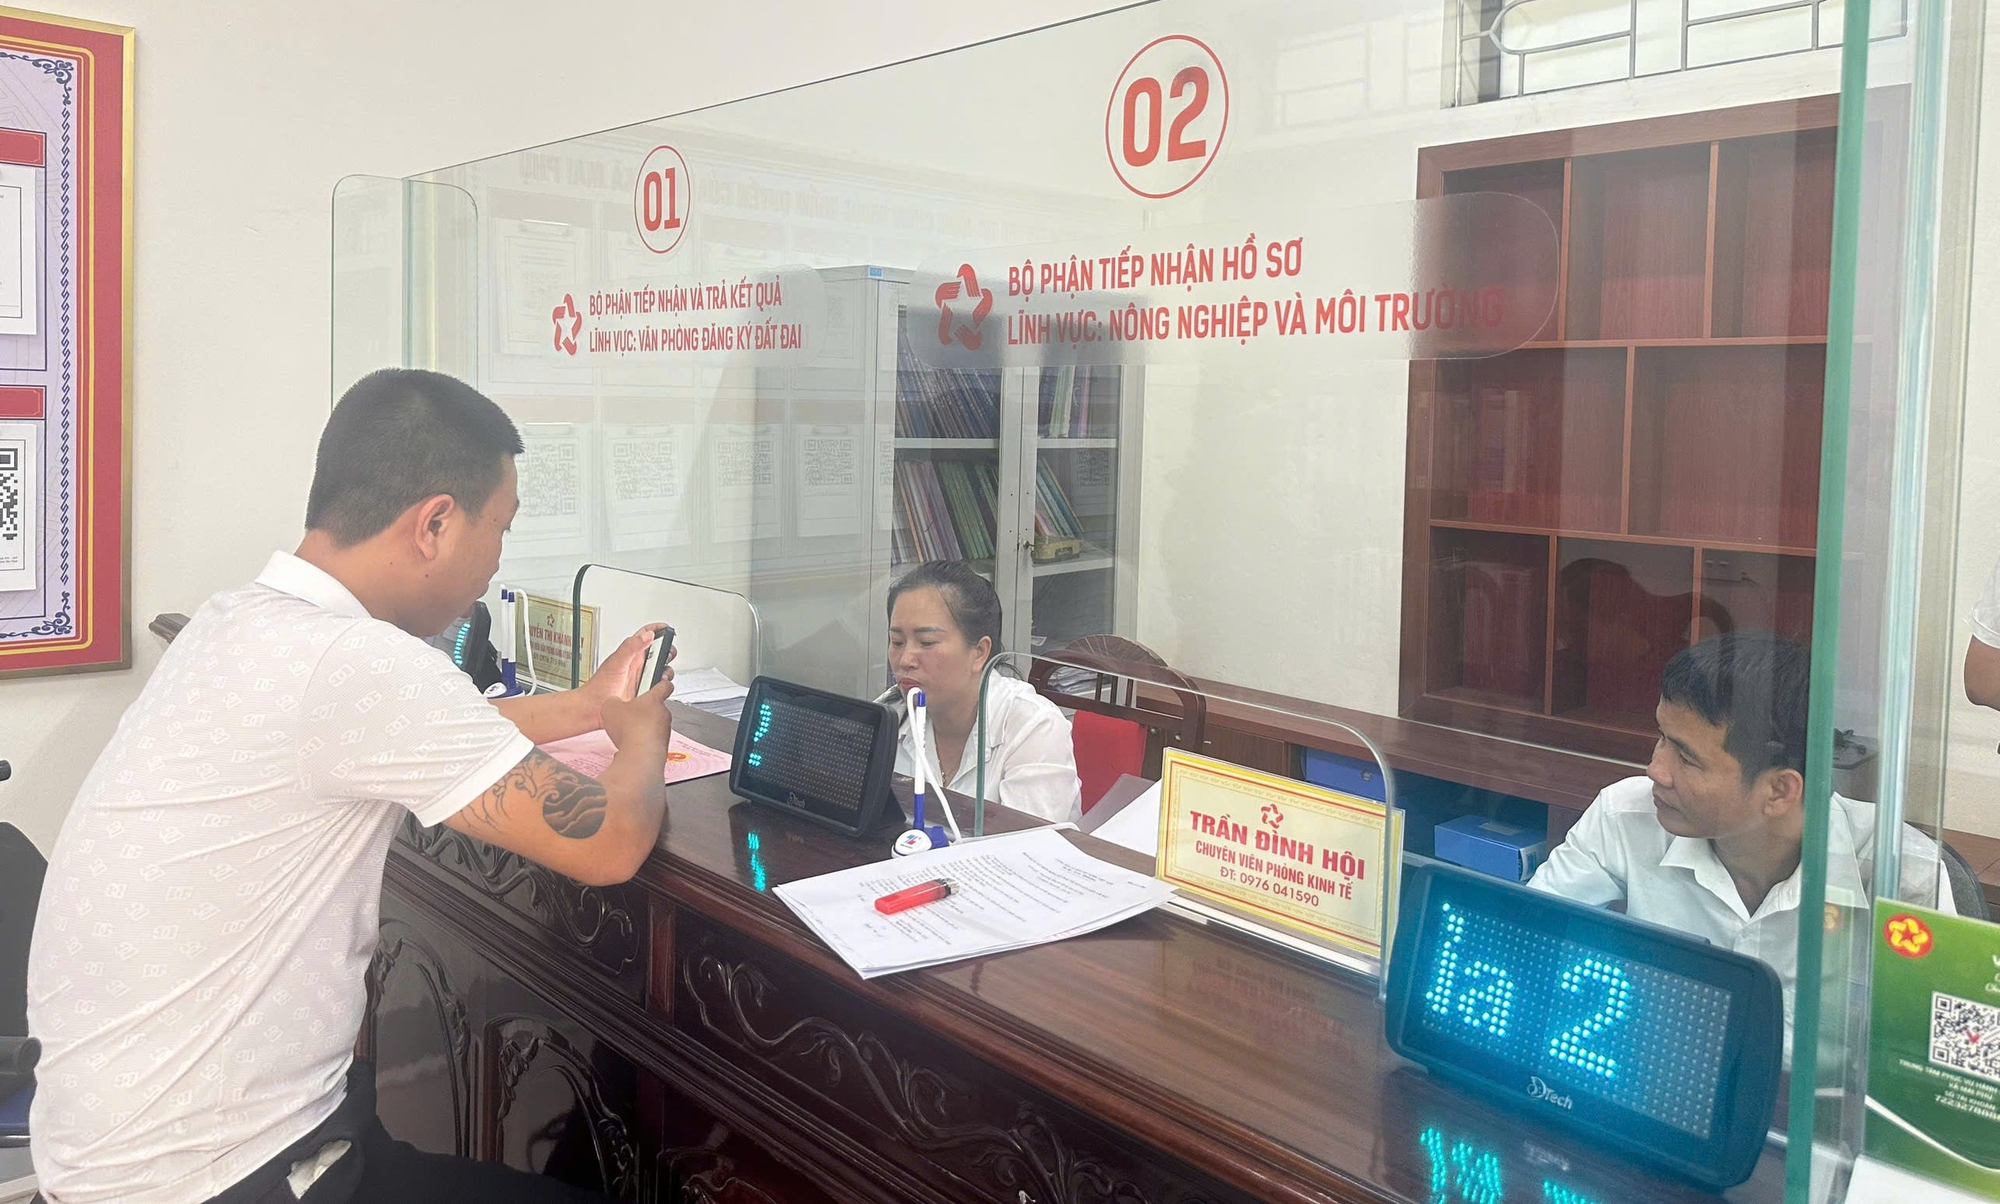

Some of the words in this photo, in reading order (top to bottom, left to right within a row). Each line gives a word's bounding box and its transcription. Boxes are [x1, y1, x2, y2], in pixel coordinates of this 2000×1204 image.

[1122, 66, 1210, 168] 02
[643, 167, 681, 232] 01
[589, 290, 602, 320] BỘ
[605, 288, 632, 319] PHẬN
[634, 283, 655, 313] TIẾP
[658, 284, 687, 317] NHẬN
[690, 282, 704, 311] VÀ
[706, 279, 727, 309] TRẢ
[730, 275, 753, 308] KẾT
[756, 274, 782, 312] QUẢ
[1009, 259, 1034, 302] BỘ
[1041, 254, 1093, 299] PHẬN
[1099, 245, 1144, 290] TIẾP
[1151, 243, 1214, 292] NHẬN
[1222, 233, 1257, 281] HỒ
[1266, 237, 1303, 278] SƠ
[589, 327, 611, 352] LĨNH
[613, 329, 636, 357] VỰC:
[639, 325, 658, 351] VĂN
[661, 323, 699, 351] PHÒNG
[702, 322, 733, 350] ĐĂNG
[736, 320, 752, 350] KÝ
[755, 316, 778, 349] ĐẤT
[780, 324, 802, 349] ĐAI
[1008, 309, 1050, 345] LĨNH
[1056, 309, 1103, 350] VỰC:
[1109, 302, 1170, 342] NÔNG
[1177, 295, 1268, 345] NGHIỆP
[1275, 292, 1307, 335] VÀ
[1315, 288, 1366, 334] MÔI
[1375, 283, 1504, 332] TRƯỜNG
[1189, 810, 1248, 845] TRẦN
[1255, 829, 1313, 865] ĐÌNH
[1322, 848, 1365, 880] HỘI
[1195, 840, 1236, 864] CHUYÊN
[1239, 853, 1263, 872] VIÊN
[1266, 862, 1304, 885] PHÒNG
[1307, 873, 1335, 895] KINH
[1338, 880, 1352, 900] TẾ
[1220, 866, 1236, 881] ĐT:
[1240, 872, 1269, 891] 0976
[1273, 883, 1319, 907] 041590
[1548, 958, 1631, 1080] 2
